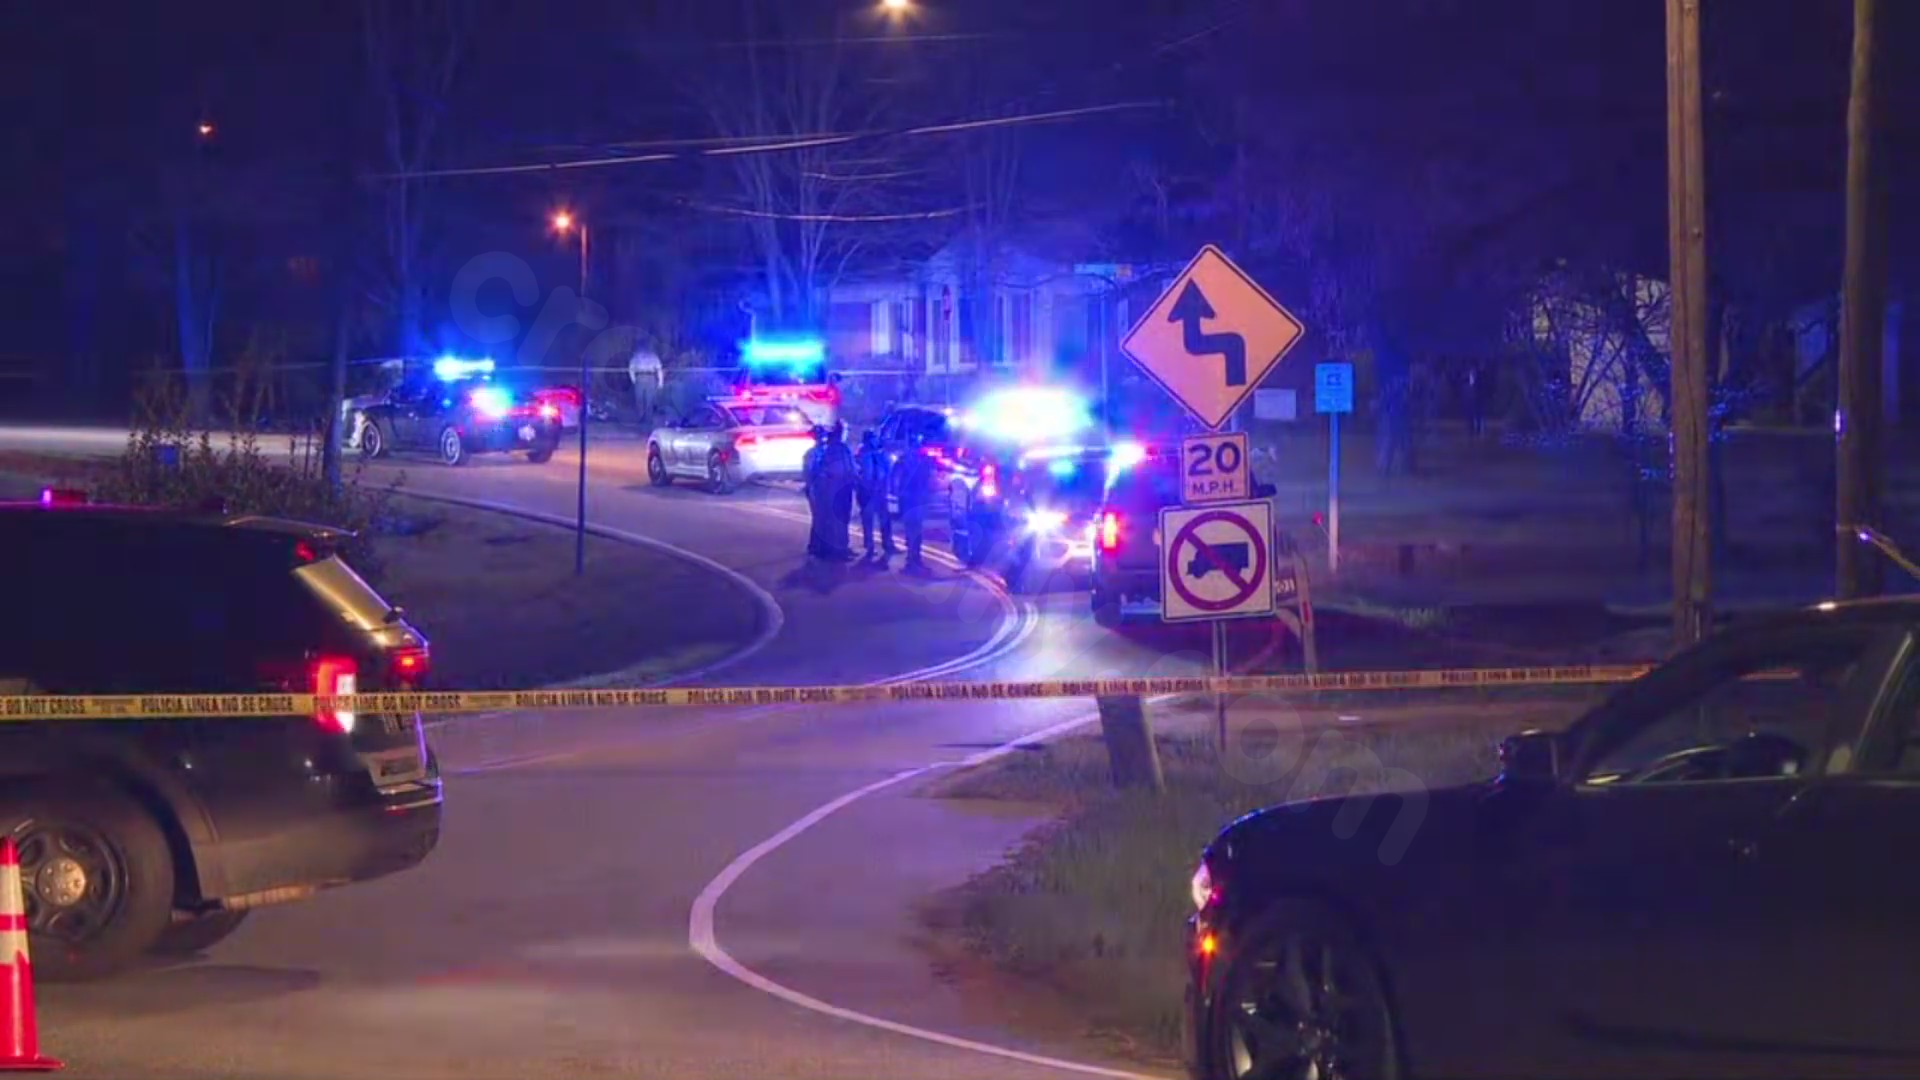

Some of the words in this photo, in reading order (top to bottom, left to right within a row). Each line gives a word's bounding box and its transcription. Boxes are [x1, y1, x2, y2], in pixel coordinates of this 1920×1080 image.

[1187, 441, 1241, 476] 20
[1192, 480, 1240, 496] M.P.H.
[424, 694, 461, 709] CROSS
[515, 691, 558, 706] POLICIA
[687, 688, 726, 704] POLICE
[24, 698, 48, 714] NOT
[49, 698, 84, 713] CROSS
[140, 697, 183, 713] POLICIA
[186, 697, 219, 713] LINEA
[222, 697, 239, 712] NO
[242, 696, 256, 712] SE
[258, 696, 293, 711] CRUCE
